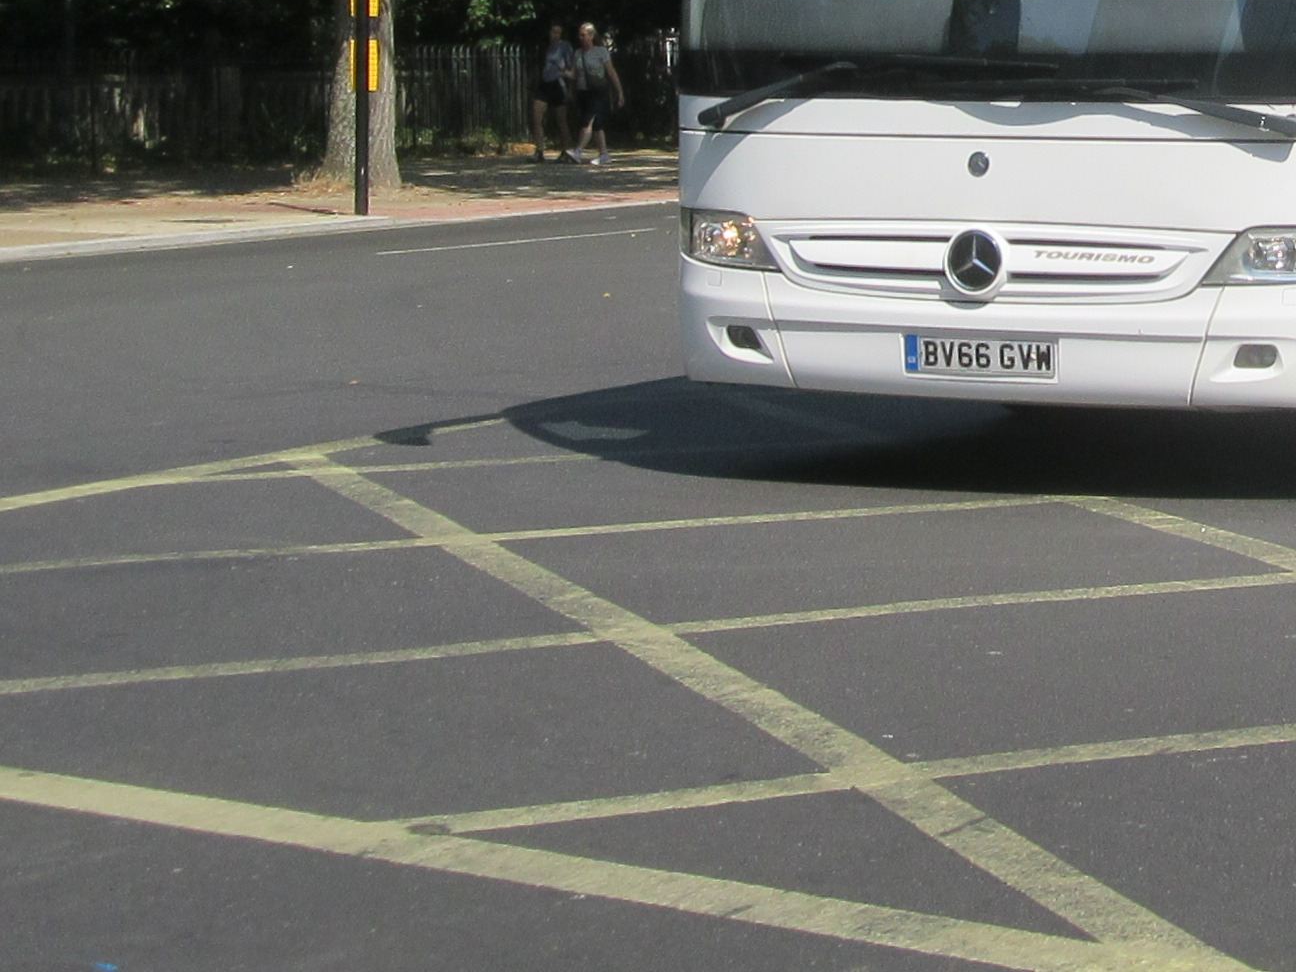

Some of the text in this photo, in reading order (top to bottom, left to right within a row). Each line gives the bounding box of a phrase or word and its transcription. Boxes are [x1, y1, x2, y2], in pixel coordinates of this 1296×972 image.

[1034, 250, 1155, 263] TOURISMO
[922, 340, 1051, 371] BV66 GVW
